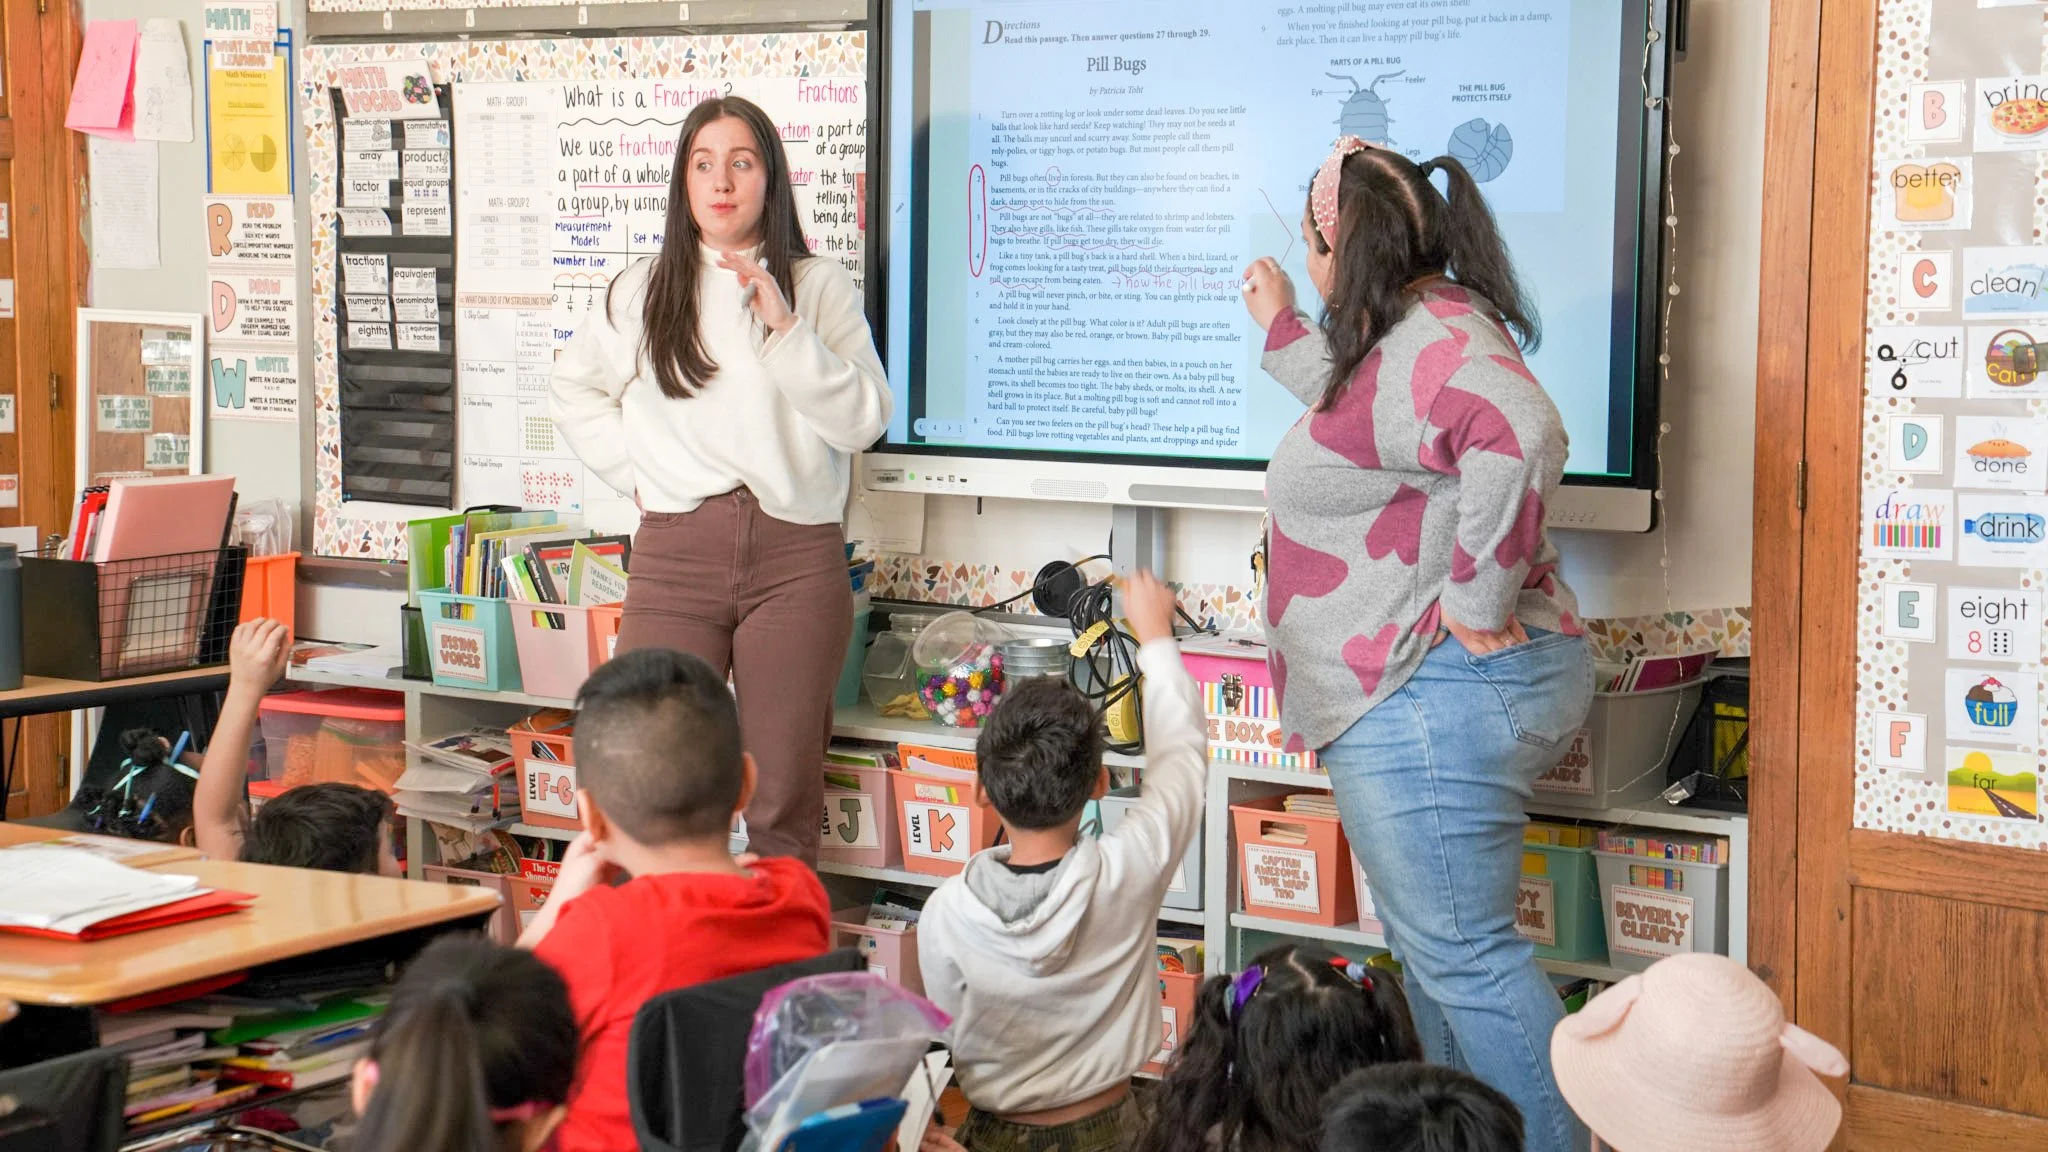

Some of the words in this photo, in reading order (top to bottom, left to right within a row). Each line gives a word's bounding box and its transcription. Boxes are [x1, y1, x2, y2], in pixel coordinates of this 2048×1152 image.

[205, 8, 250, 30] MATH
[215, 40, 242, 52] WHAT
[1004, 35, 1023, 44] Read
[1024, 35, 1038, 44] this
[1039, 36, 1070, 45] passage.
[1070, 33, 1090, 42] Then
[1119, 31, 1154, 42] questions
[1155, 30, 1166, 39] 27
[1166, 29, 1198, 41] through
[1198, 28, 1211, 37] 29.
[1276, 36, 1293, 46] dark
[1294, 35, 1317, 47] place.
[1319, 34, 1338, 44] Then
[1339, 34, 1345, 44] it
[1362, 33, 1376, 43] live
[1384, 32, 1407, 44] happy
[1410, 31, 1423, 43] pill
[1424, 30, 1446, 43] bug's
[1448, 30, 1462, 40] life.
[222, 54, 266, 66] LEARNING
[1086, 56, 1108, 72] Pill
[1113, 56, 1147, 75] Bugs
[1330, 58, 1351, 66] PARTS
[339, 66, 388, 88] MATH
[564, 86, 604, 108] What
[612, 86, 624, 107] is
[636, 91, 647, 108] a
[798, 80, 858, 103] Fractions
[1089, 86, 1098, 96] by
[1100, 86, 1126, 95] Patricia
[1127, 86, 1144, 94] Toht
[1311, 89, 1323, 98] Eye
[1452, 94, 1488, 103] PROTECTS
[1489, 94, 1512, 102] ITSELF
[345, 90, 402, 113] VOCAB
[487, 96, 501, 106] MATH
[506, 96, 524, 107] GROUP
[1922, 90, 1947, 130] B
[345, 118, 390, 126] multiplication
[817, 125, 823, 137] a
[828, 119, 852, 141] part
[856, 121, 866, 136] of
[560, 138, 580, 157] We
[590, 142, 614, 156] use
[620, 134, 679, 156] fractions
[816, 142, 827, 155] of
[830, 144, 836, 155] a
[840, 143, 865, 160] group
[1405, 148, 1420, 157] Legs
[359, 152, 382, 161] array
[404, 151, 442, 164] product
[352, 181, 379, 192] factor
[404, 180, 424, 188] equal
[426, 180, 448, 188] groups
[558, 170, 566, 182] a
[573, 164, 599, 191] part
[604, 165, 616, 183] of
[623, 169, 631, 183] a
[637, 163, 670, 184] whole
[821, 169, 837, 185] the
[1895, 168, 1961, 188] better
[488, 197, 503, 207] MATH
[507, 197, 525, 207] GROUP
[558, 198, 567, 210] a
[614, 194, 629, 216] by
[634, 194, 667, 217] using
[816, 191, 847, 208] telling
[246, 202, 275, 218] READ
[406, 205, 446, 216] represent
[814, 209, 838, 228] being
[207, 203, 233, 256] R
[555, 221, 612, 232] Measurement
[571, 235, 600, 246] Models
[634, 233, 647, 244] Set
[826, 235, 844, 252] the
[346, 256, 385, 266] fractions
[553, 256, 585, 266] Number
[590, 256, 610, 267] Line:
[394, 270, 435, 279] equivalent
[1912, 258, 1938, 298] C
[1126, 276, 1149, 289] how
[1153, 276, 1172, 288] the
[1178, 276, 1197, 296] pill
[1970, 272, 2036, 297] clean
[212, 280, 236, 332] D
[348, 297, 386, 305] numerator
[358, 325, 388, 337] eighths
[1916, 336, 1959, 359] cut
[211, 358, 247, 409] W
[1026, 403, 1050, 413] protect
[1081, 405, 1107, 414] careful,
[1108, 406, 1125, 416] baby
[1126, 407, 1138, 416] pill
[1139, 407, 1158, 417] bugs!
[1903, 423, 1928, 461] D
[1975, 457, 2028, 473] done
[1876, 491, 1945, 520] draw
[1980, 515, 2040, 539] drink
[1898, 590, 1920, 628] E
[1960, 596, 2029, 624] eight
[440, 634, 478, 653] RISING
[1968, 630, 1982, 653] 8
[440, 650, 481, 670] VOICES
[1974, 702, 2009, 725] full
[1224, 720, 1264, 744] BOX
[1890, 720, 1911, 757] F
[538, 772, 574, 806] F-G
[1973, 774, 1997, 790] far
[837, 798, 861, 844] J
[911, 814, 921, 843] LEVEL
[928, 809, 955, 852] K
[1261, 854, 1301, 869] CAPTAIN
[1254, 864, 1300, 880] AWESOME
[1257, 875, 1280, 888] TIME
[1282, 878, 1308, 891] WARP
[1615, 900, 1690, 929] BEVERLY
[1620, 920, 1685, 946] CLEARY
